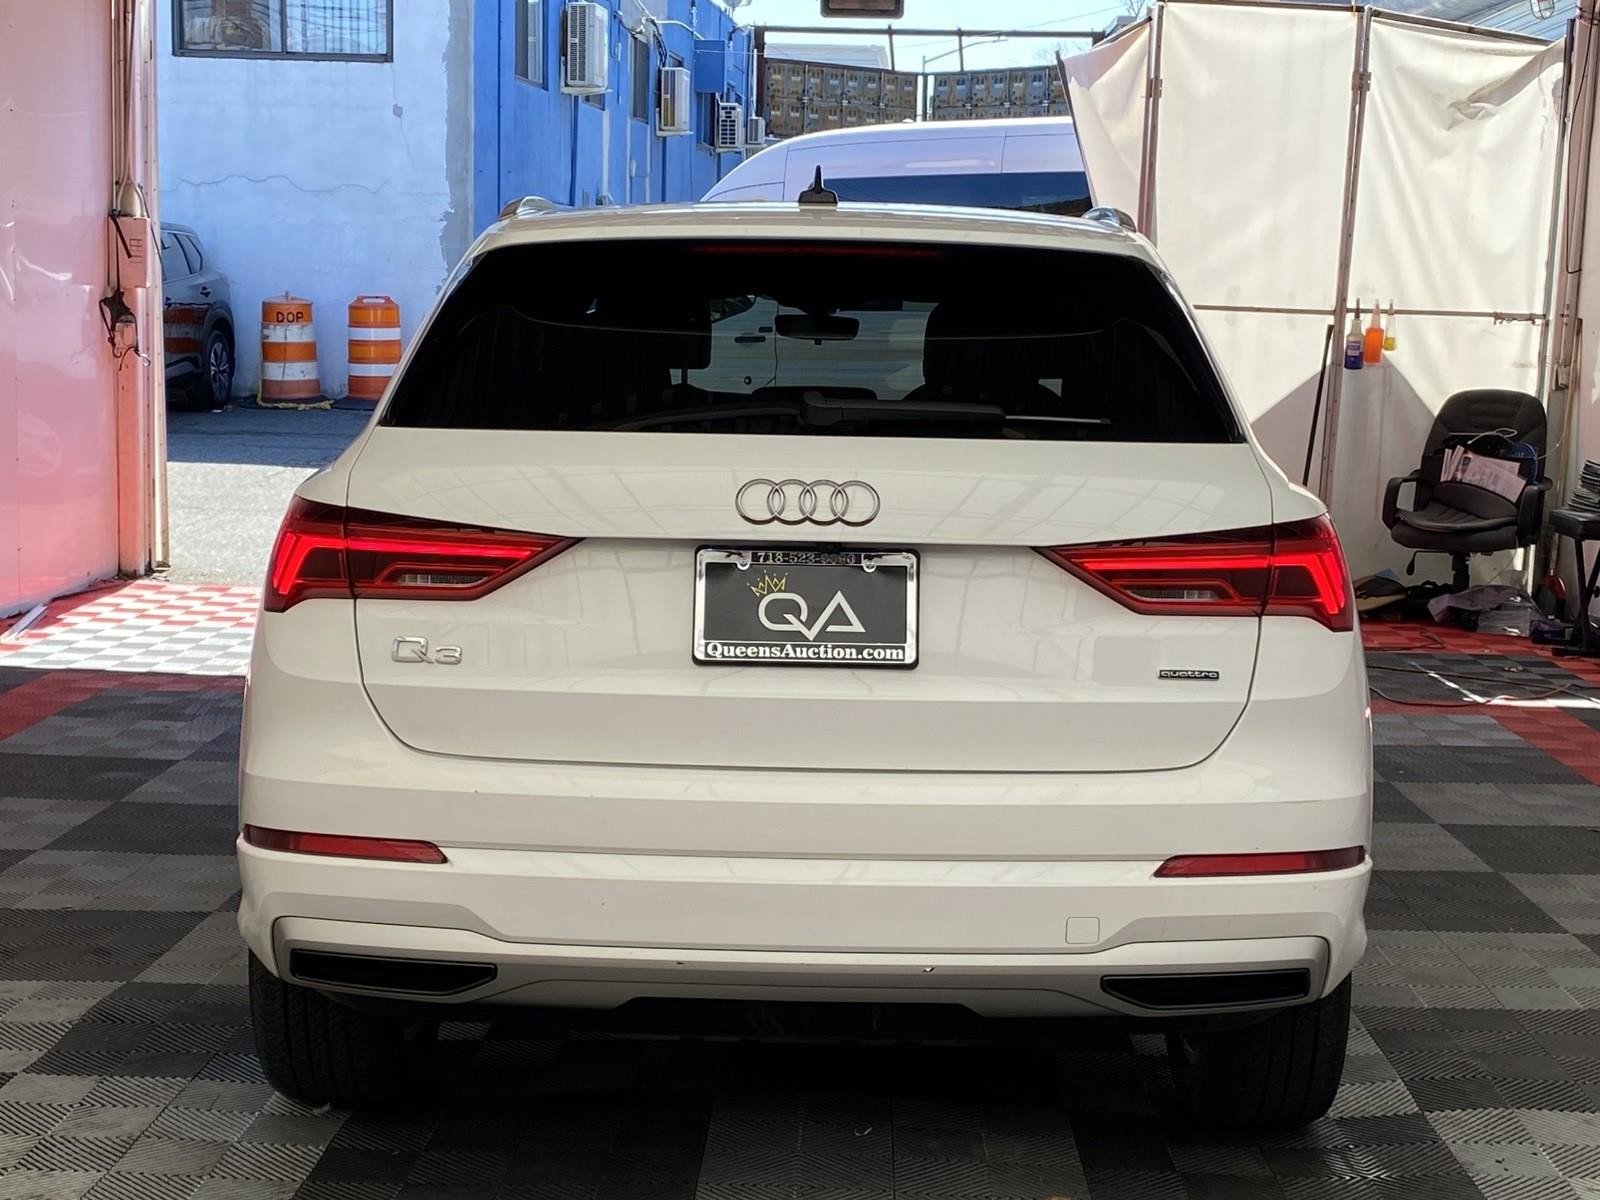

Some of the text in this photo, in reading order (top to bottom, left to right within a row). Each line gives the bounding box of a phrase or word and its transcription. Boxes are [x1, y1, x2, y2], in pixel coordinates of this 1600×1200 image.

[276, 311, 304, 323] DOP
[391, 636, 463, 665] Q3
[706, 643, 904, 660] QueensAuction.com
[1160, 671, 1218, 679] quattro
